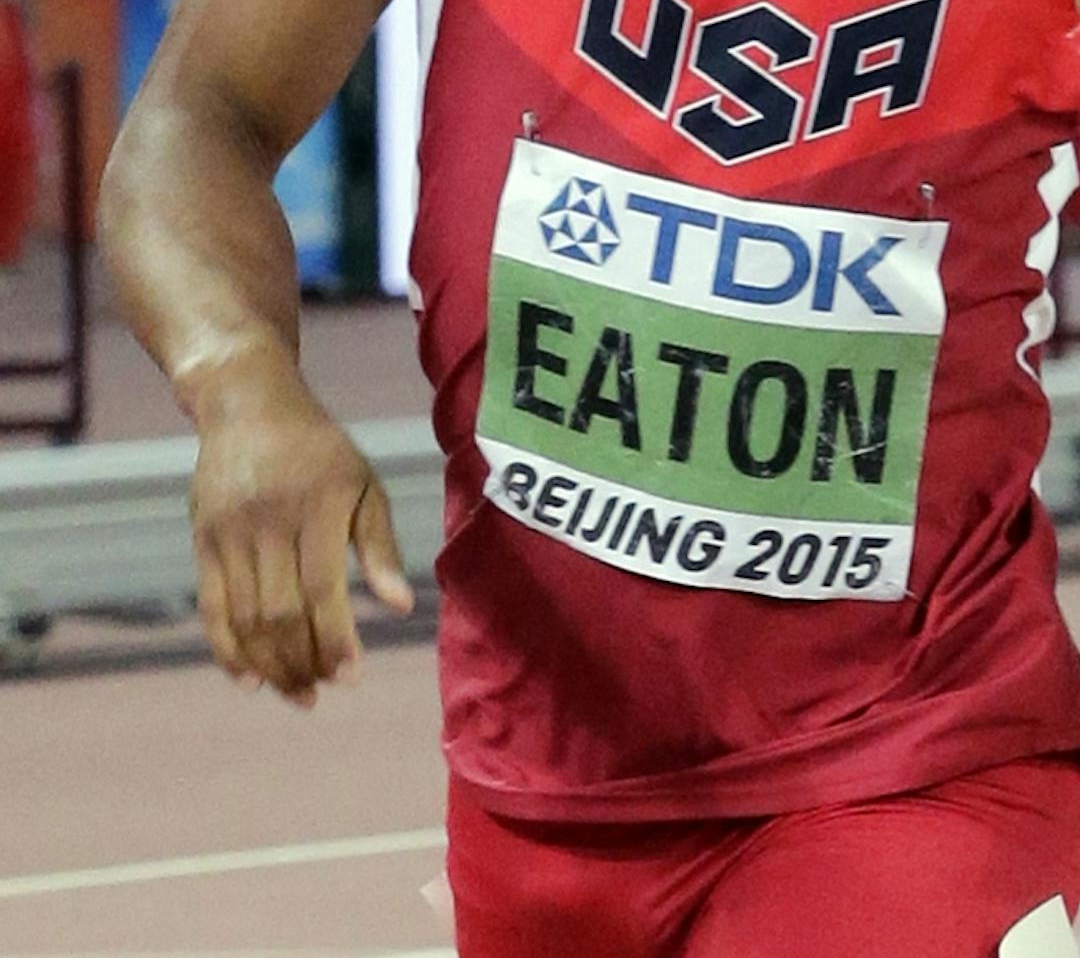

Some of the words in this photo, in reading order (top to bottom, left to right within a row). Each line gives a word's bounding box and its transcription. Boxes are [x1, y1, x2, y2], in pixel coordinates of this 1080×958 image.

[624, 192, 904, 318] TDK
[511, 299, 898, 486] EATON
[502, 461, 726, 573] BEIJING
[734, 529, 890, 589] 2015
